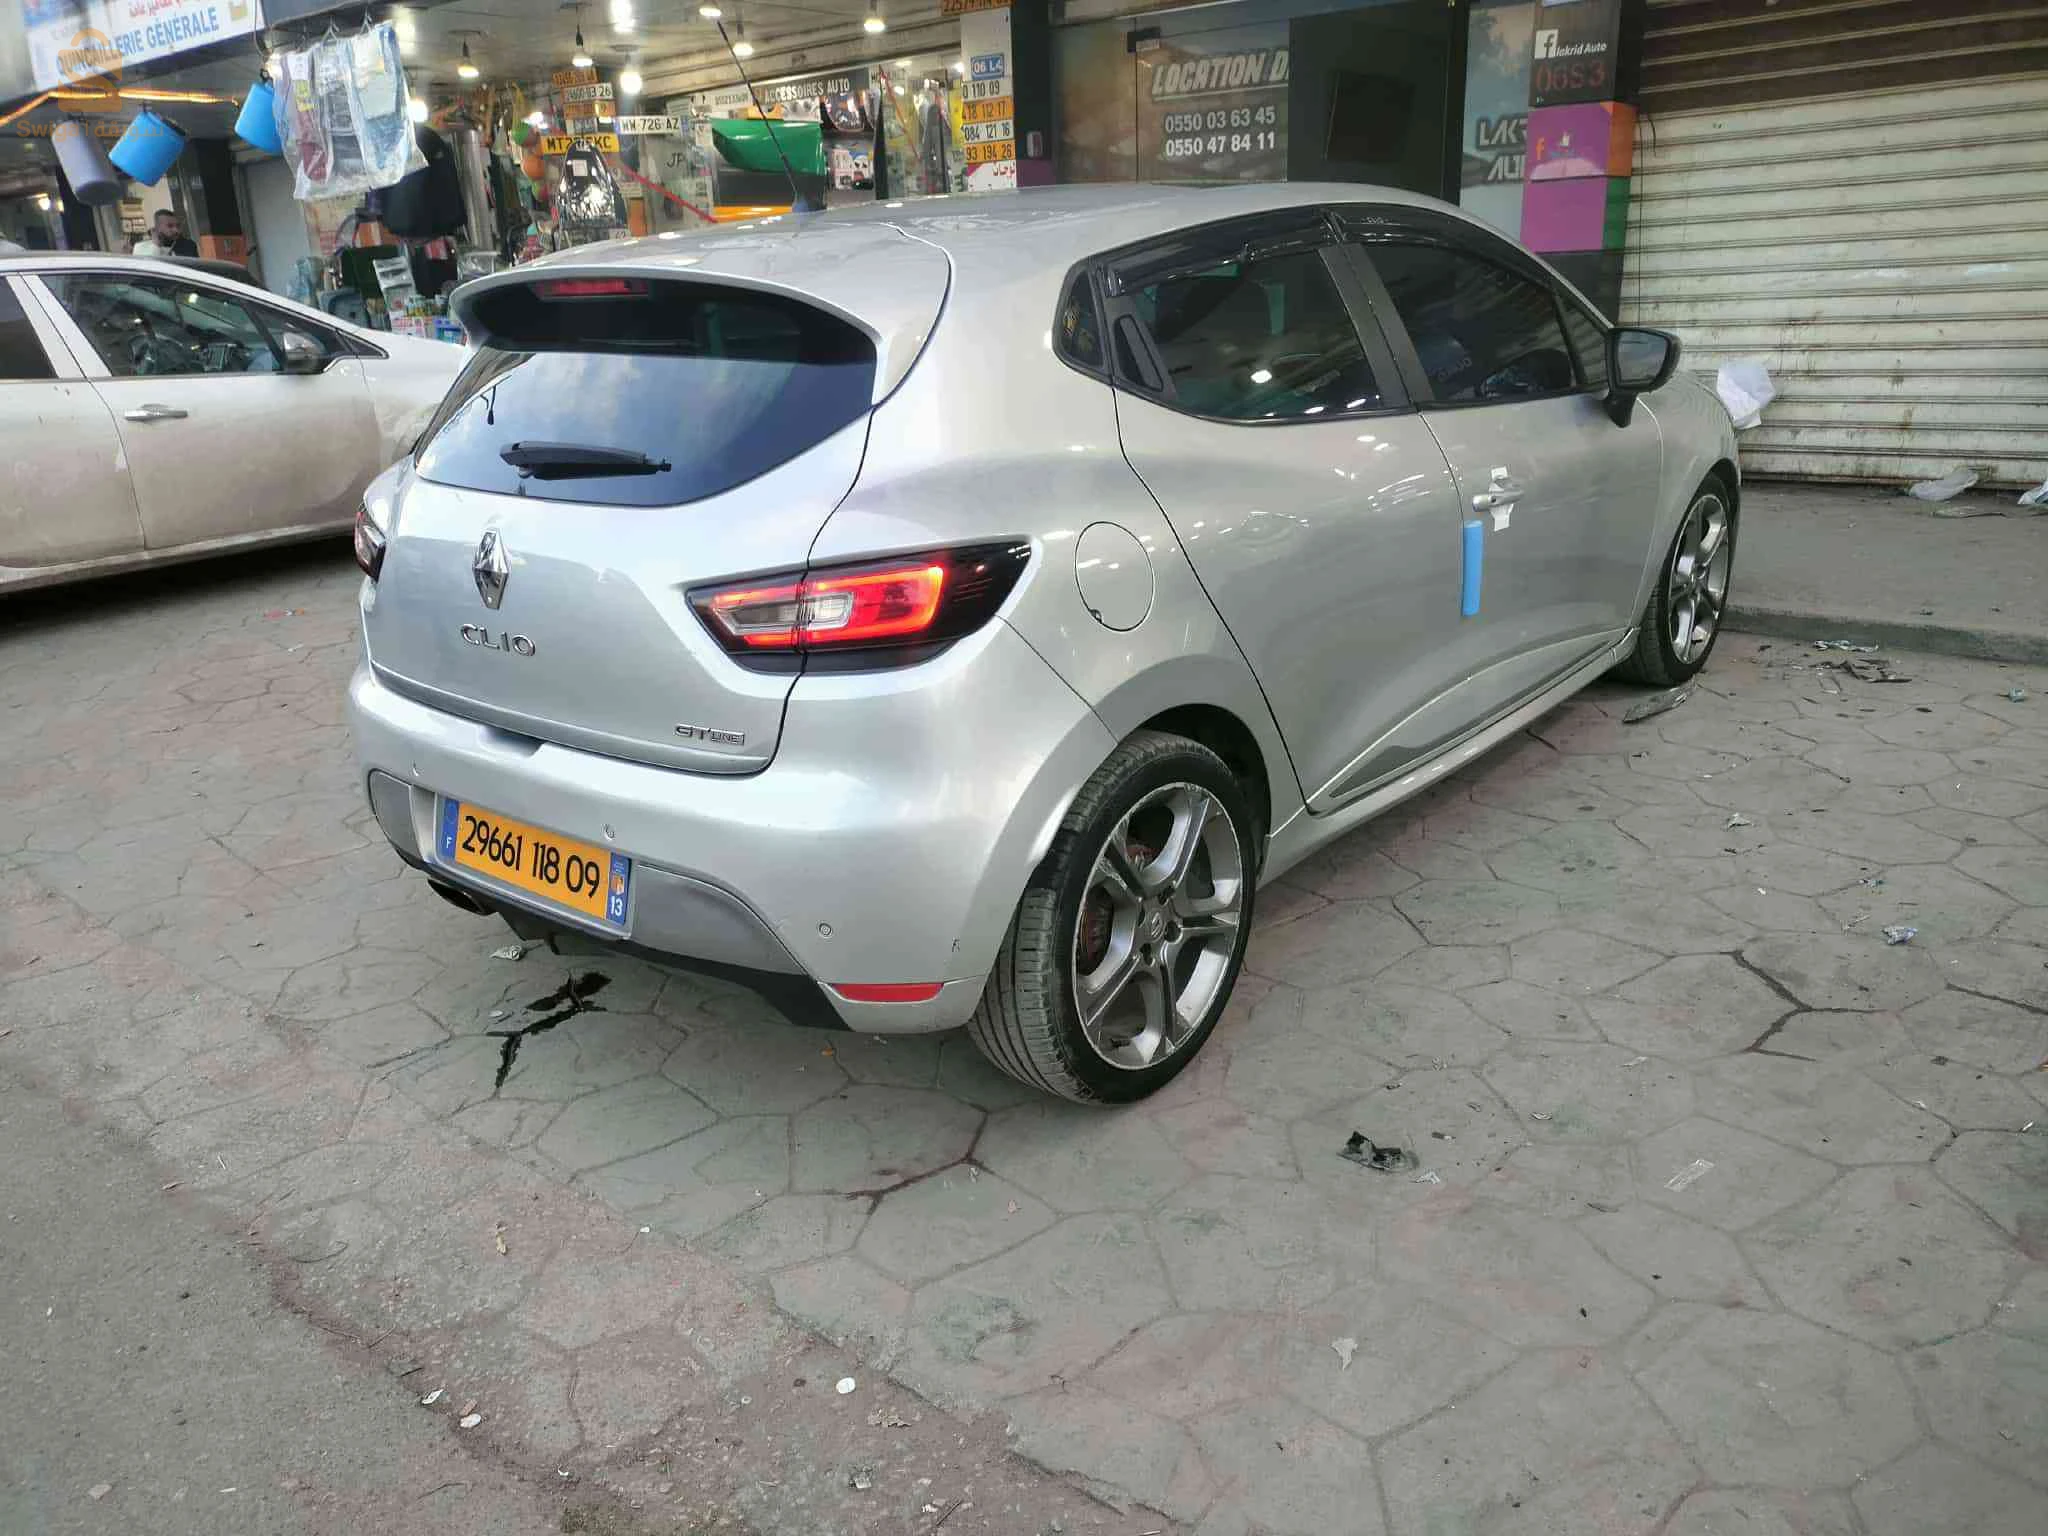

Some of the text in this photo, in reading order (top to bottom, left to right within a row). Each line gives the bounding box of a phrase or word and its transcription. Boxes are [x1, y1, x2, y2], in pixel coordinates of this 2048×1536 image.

[146, 6, 220, 49] GÉNÉRALE
[1152, 50, 1289, 96] LOCATION D
[764, 80, 825, 105] ACCESSOIRES
[827, 78, 851, 94] AUTO
[641, 117, 662, 132] 726
[666, 116, 680, 131] AZ
[1165, 105, 1276, 134] 0550 03 63 45
[1165, 131, 1275, 157] 0550 47 84 11
[460, 623, 537, 657] CLIO
[445, 836, 453, 850] F
[462, 815, 602, 899] 29661 118 09
[610, 895, 624, 918] 13
